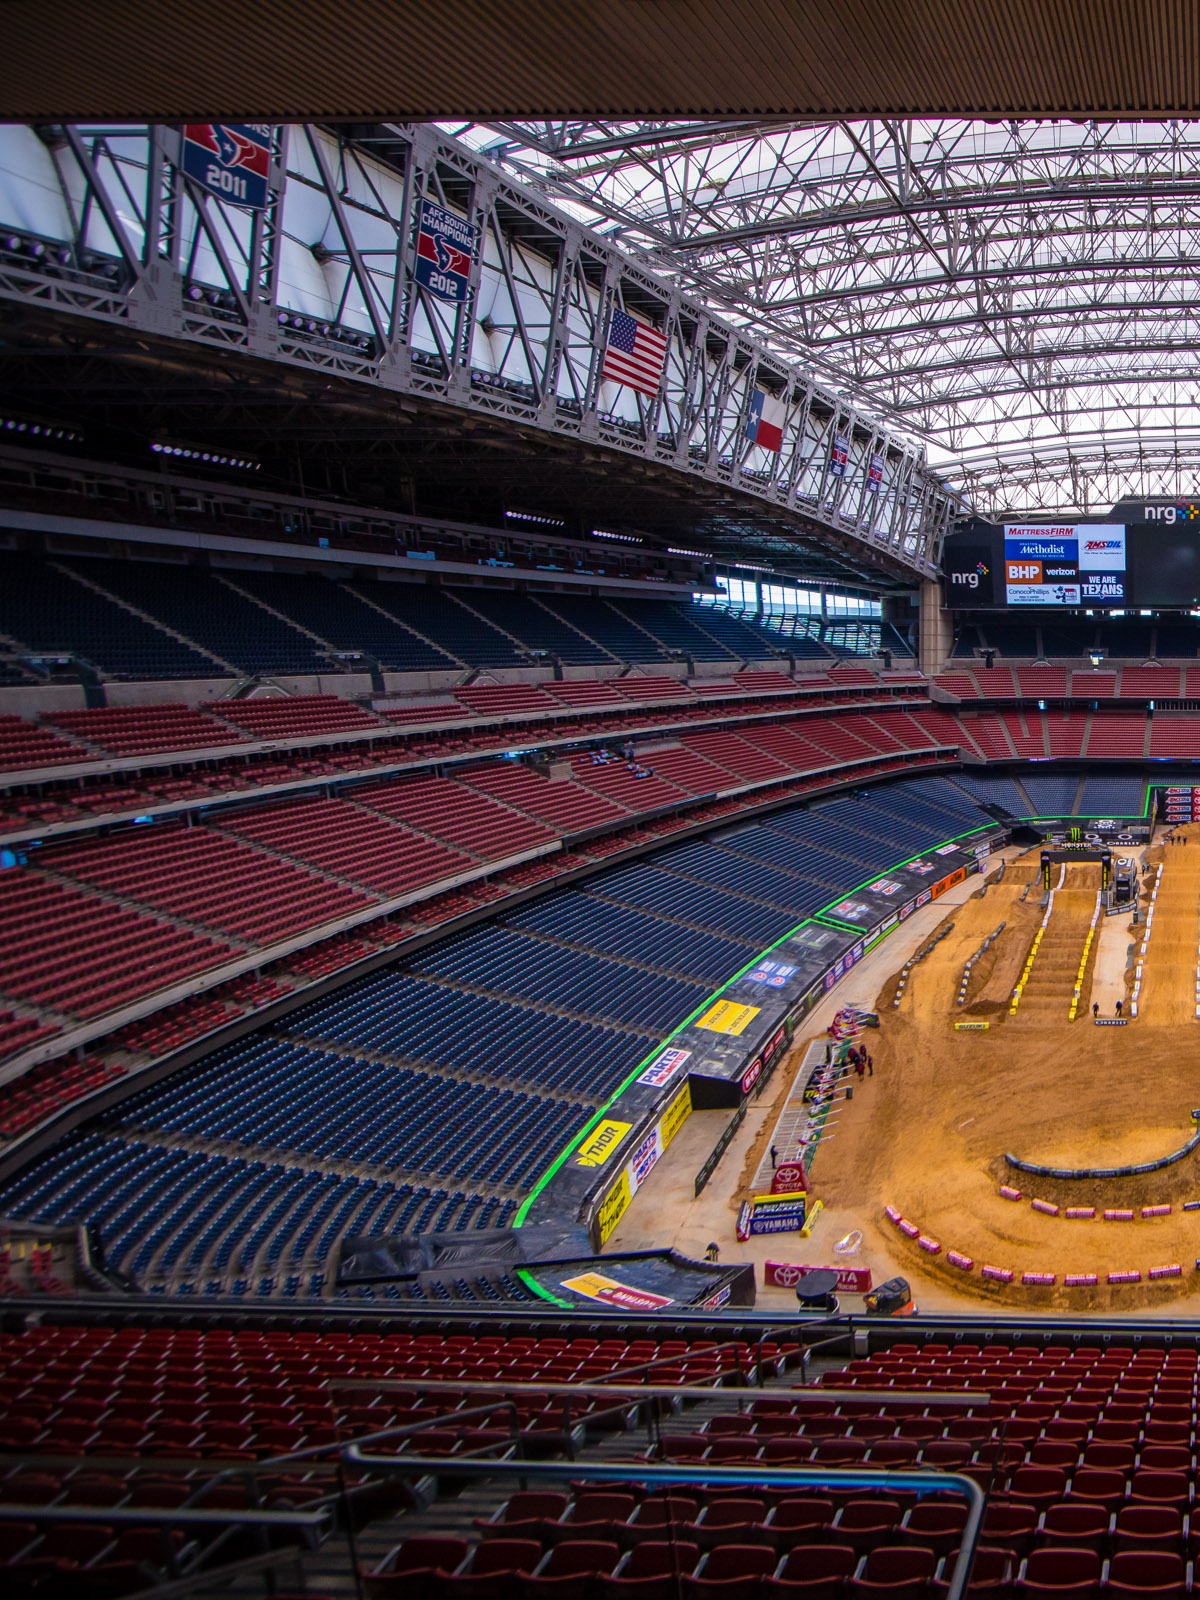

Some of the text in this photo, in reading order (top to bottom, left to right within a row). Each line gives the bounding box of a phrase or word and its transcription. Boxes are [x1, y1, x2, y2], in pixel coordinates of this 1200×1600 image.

[207, 164, 247, 200] 2011
[422, 213, 473, 248] CHAMPIONS
[428, 206, 469, 235] AFC SOUTH
[428, 272, 458, 298] 2012
[1144, 504, 1176, 524] nrg
[1020, 544, 1064, 554] Methodist
[1084, 540, 1122, 550] AMSOIL
[952, 572, 978, 588] nrg
[1008, 566, 1040, 579] BHP
[1046, 568, 1076, 576] verizon
[1082, 584, 1123, 594] TEXANS
[642, 1050, 680, 1083] PARTS
[586, 1126, 619, 1156] THOR
[633, 1129, 657, 1164] PARTS
[636, 1148, 657, 1178] PARTS
[764, 1218, 799, 1229] YAMAHA
